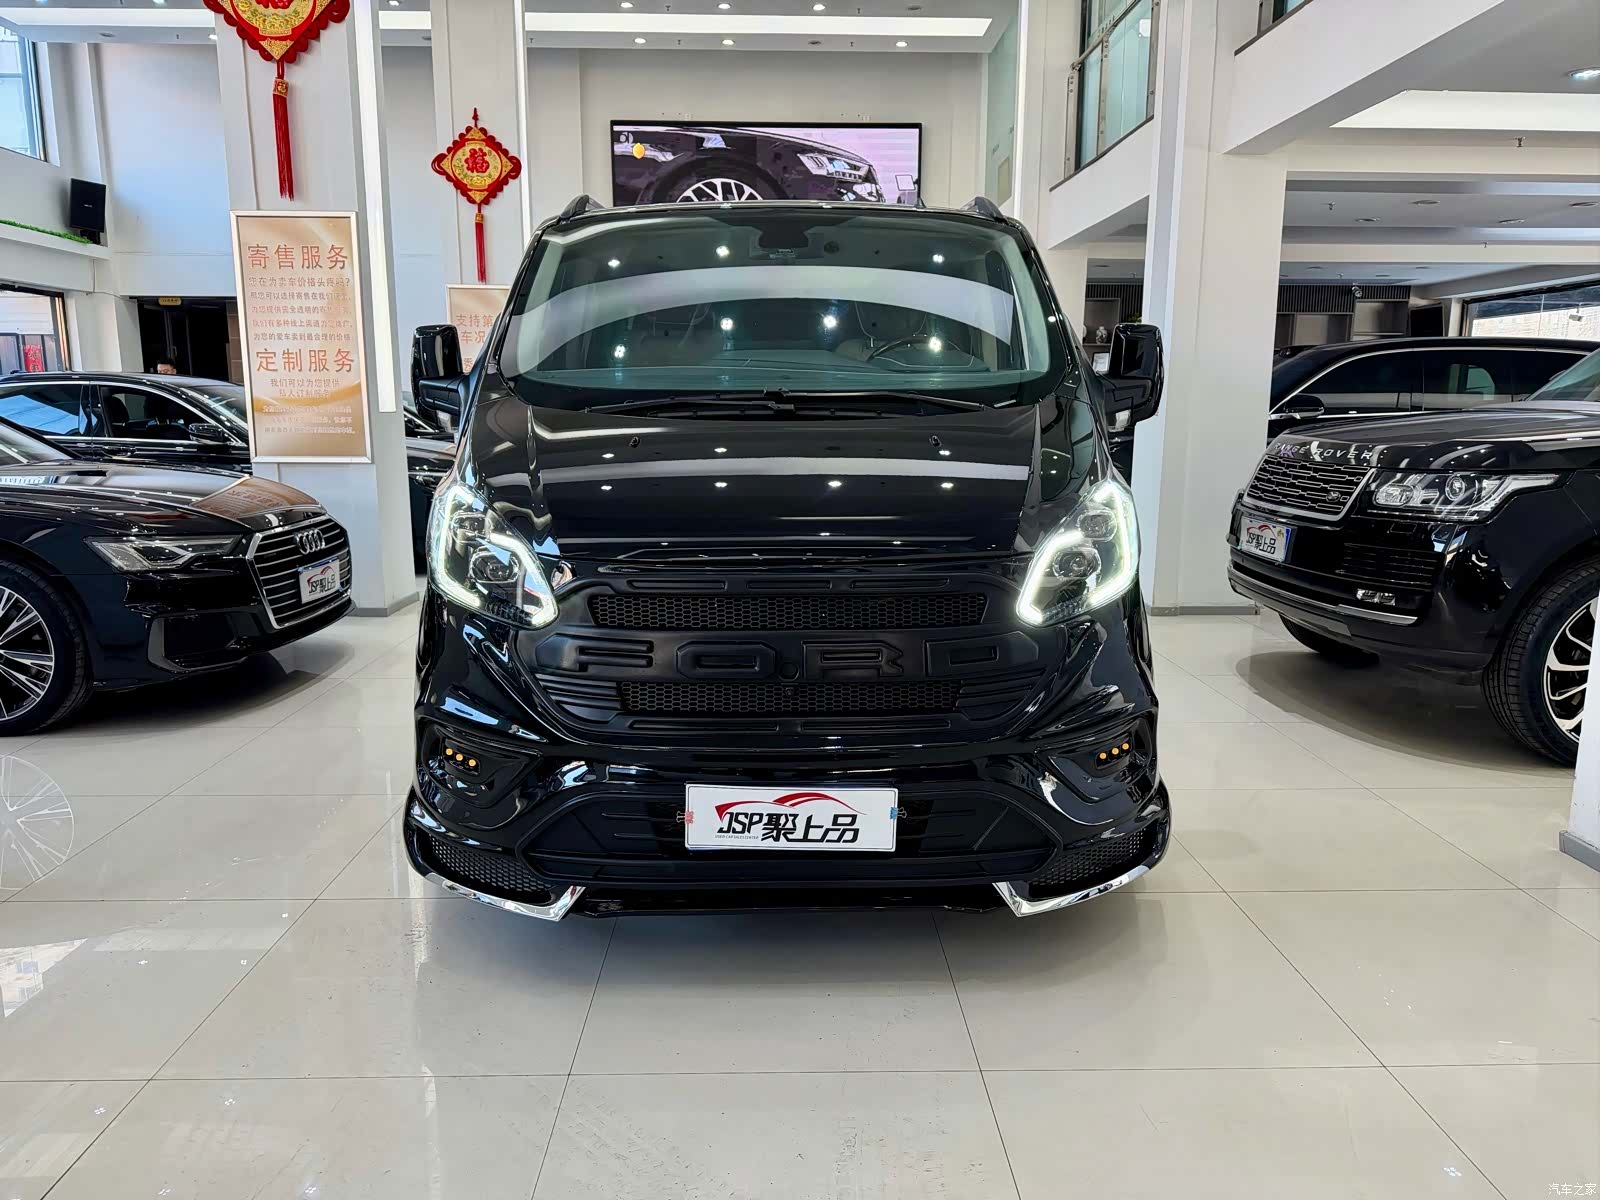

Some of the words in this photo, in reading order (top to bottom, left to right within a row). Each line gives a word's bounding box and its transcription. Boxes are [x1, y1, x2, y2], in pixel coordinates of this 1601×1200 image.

[247, 243, 348, 270] 寄售服务
[256, 348, 355, 373] 定制服务
[1273, 442, 1309, 454] RANGE
[1314, 448, 1373, 460] ROVER
